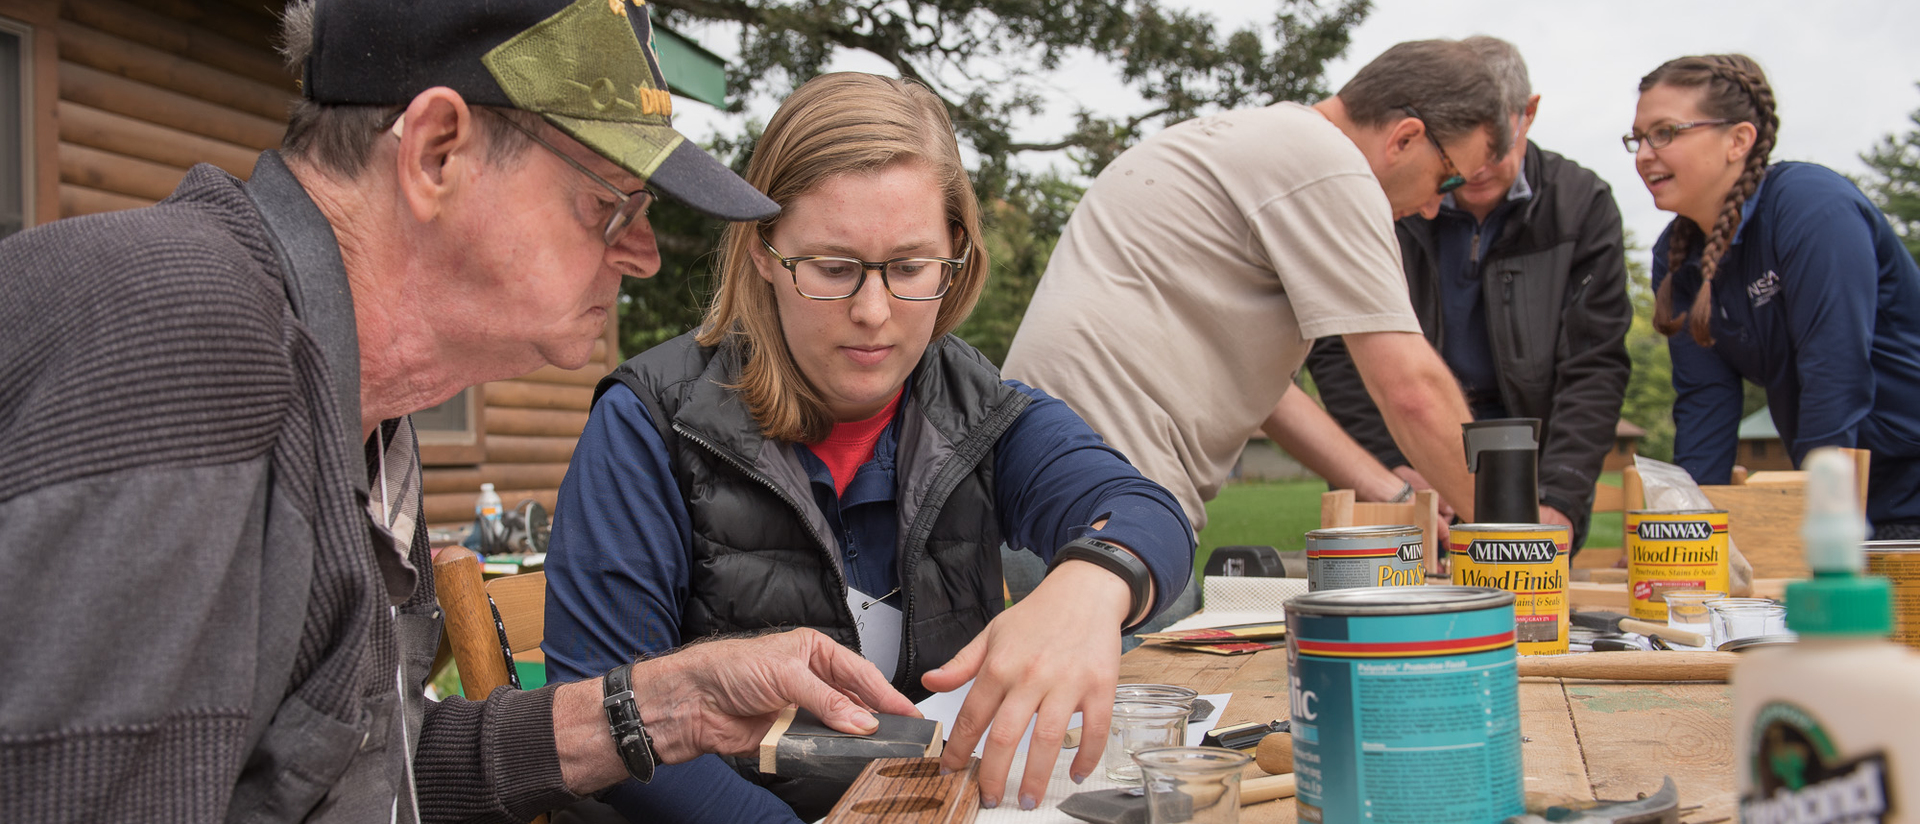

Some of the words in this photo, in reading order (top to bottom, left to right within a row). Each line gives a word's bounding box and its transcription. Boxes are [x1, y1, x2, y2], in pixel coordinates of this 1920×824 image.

[1641, 523, 1706, 538] MINWAX
[1402, 544, 1422, 560] MIN
[1475, 543, 1551, 560] MINWAX
[1633, 545, 1670, 562] Wood
[1673, 545, 1718, 562] Finish
[1462, 569, 1510, 590] Wood
[1513, 569, 1562, 590] Finish
[1669, 567, 1691, 576] Stains
[1701, 567, 1717, 576] Seals
[1514, 598, 1534, 607] tains
[1536, 597, 1544, 606] &
[1544, 597, 1560, 606] Seals
